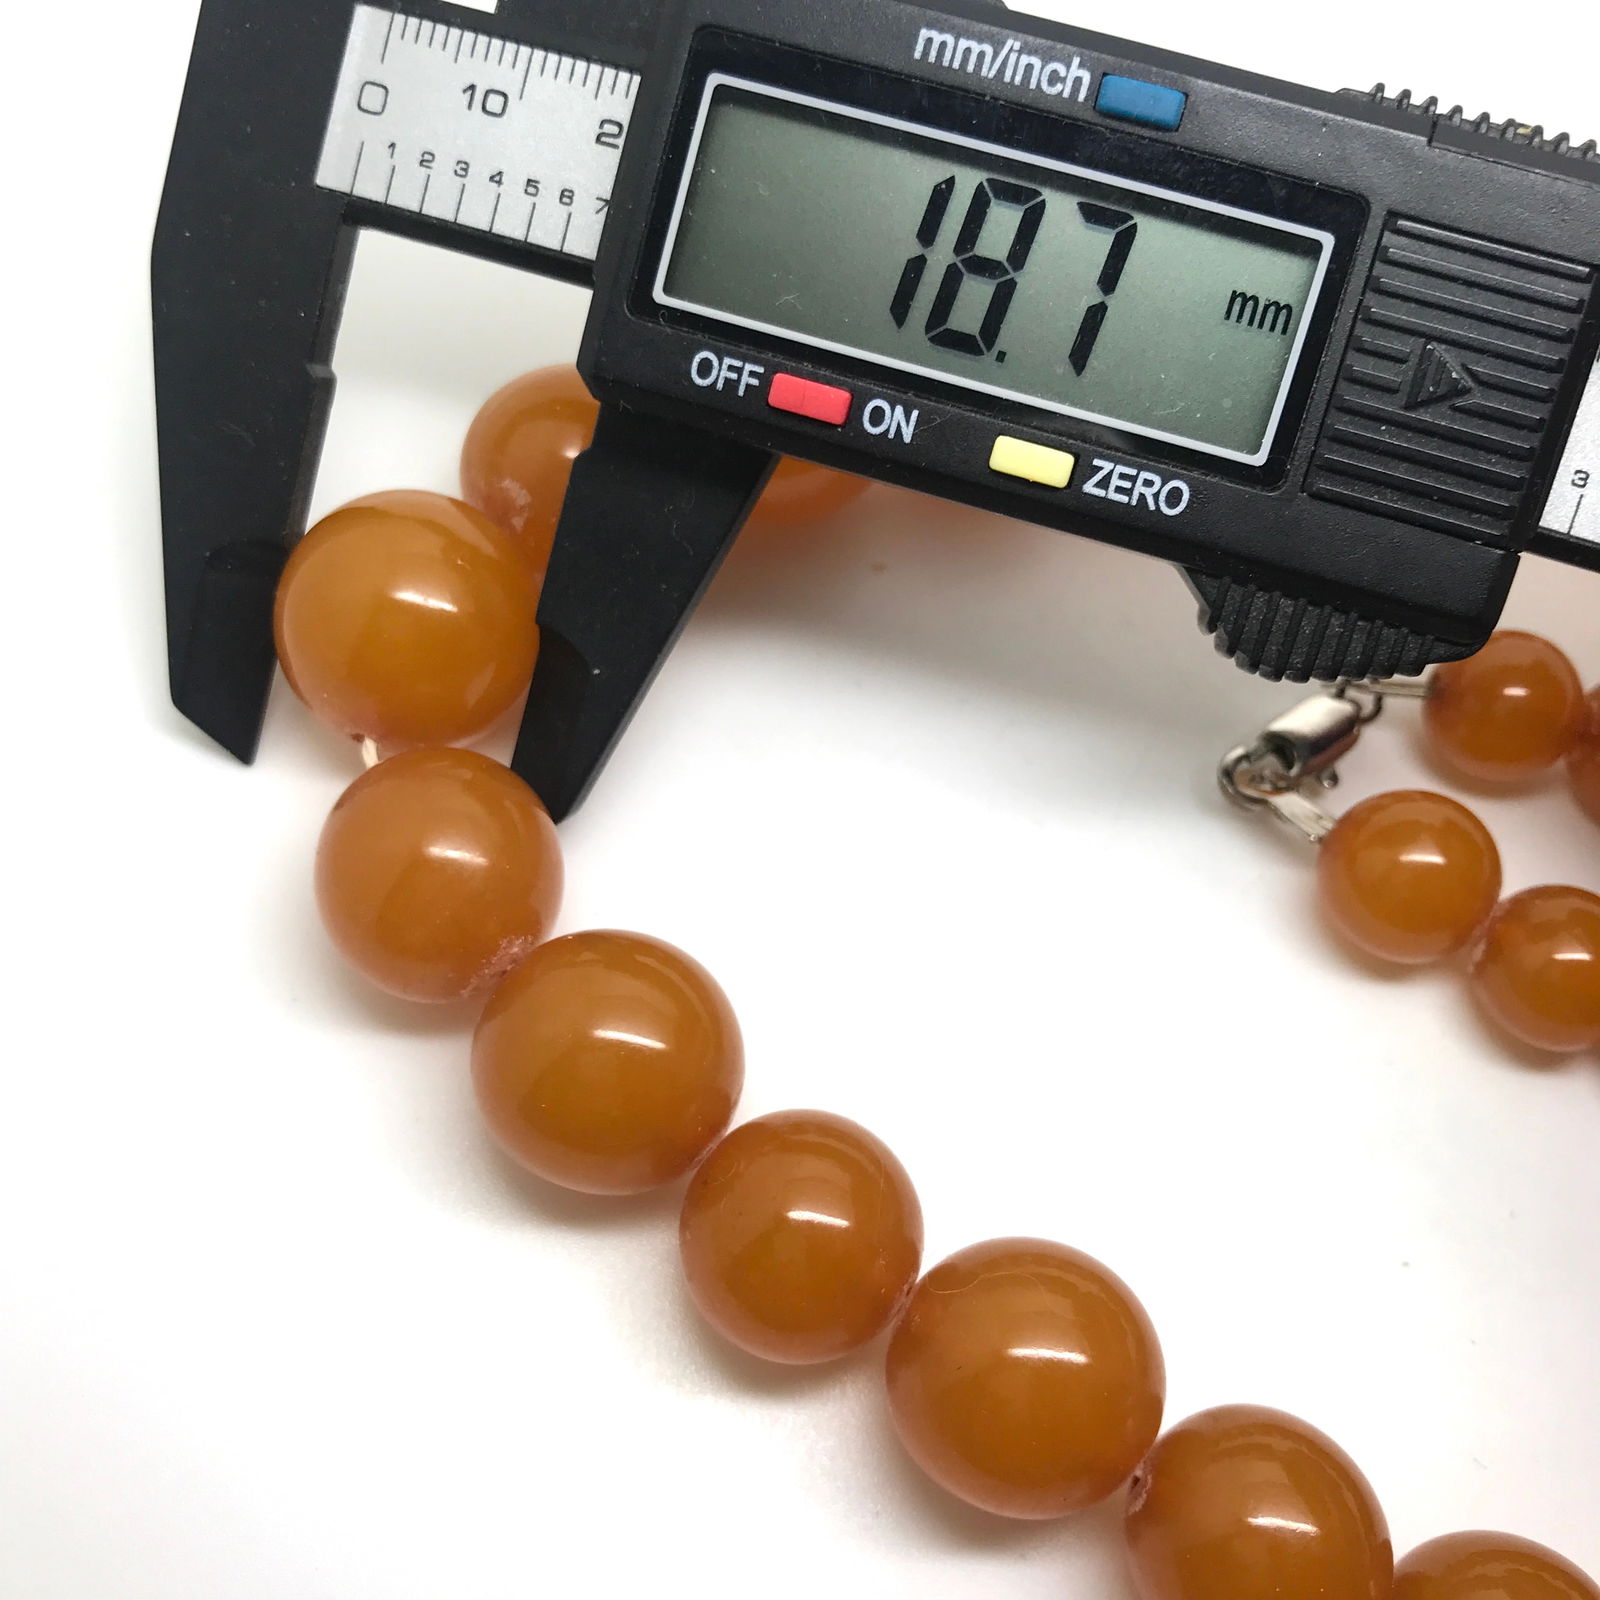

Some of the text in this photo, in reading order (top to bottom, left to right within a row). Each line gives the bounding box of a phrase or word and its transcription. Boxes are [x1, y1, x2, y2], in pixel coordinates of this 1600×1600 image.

[913, 27, 1092, 103] mm/inch
[357, 81, 389, 116] 0
[462, 84, 509, 118] 10
[387, 142, 397, 159] 1
[419, 151, 436, 169] 2
[454, 160, 470, 179] 3
[489, 171, 505, 188] 4
[524, 179, 541, 197] 5
[889, 174, 1294, 378] 18.7 mm
[690, 351, 920, 444] OFF ON
[1082, 458, 1191, 518] ZERO
[1571, 469, 1590, 488] 3
